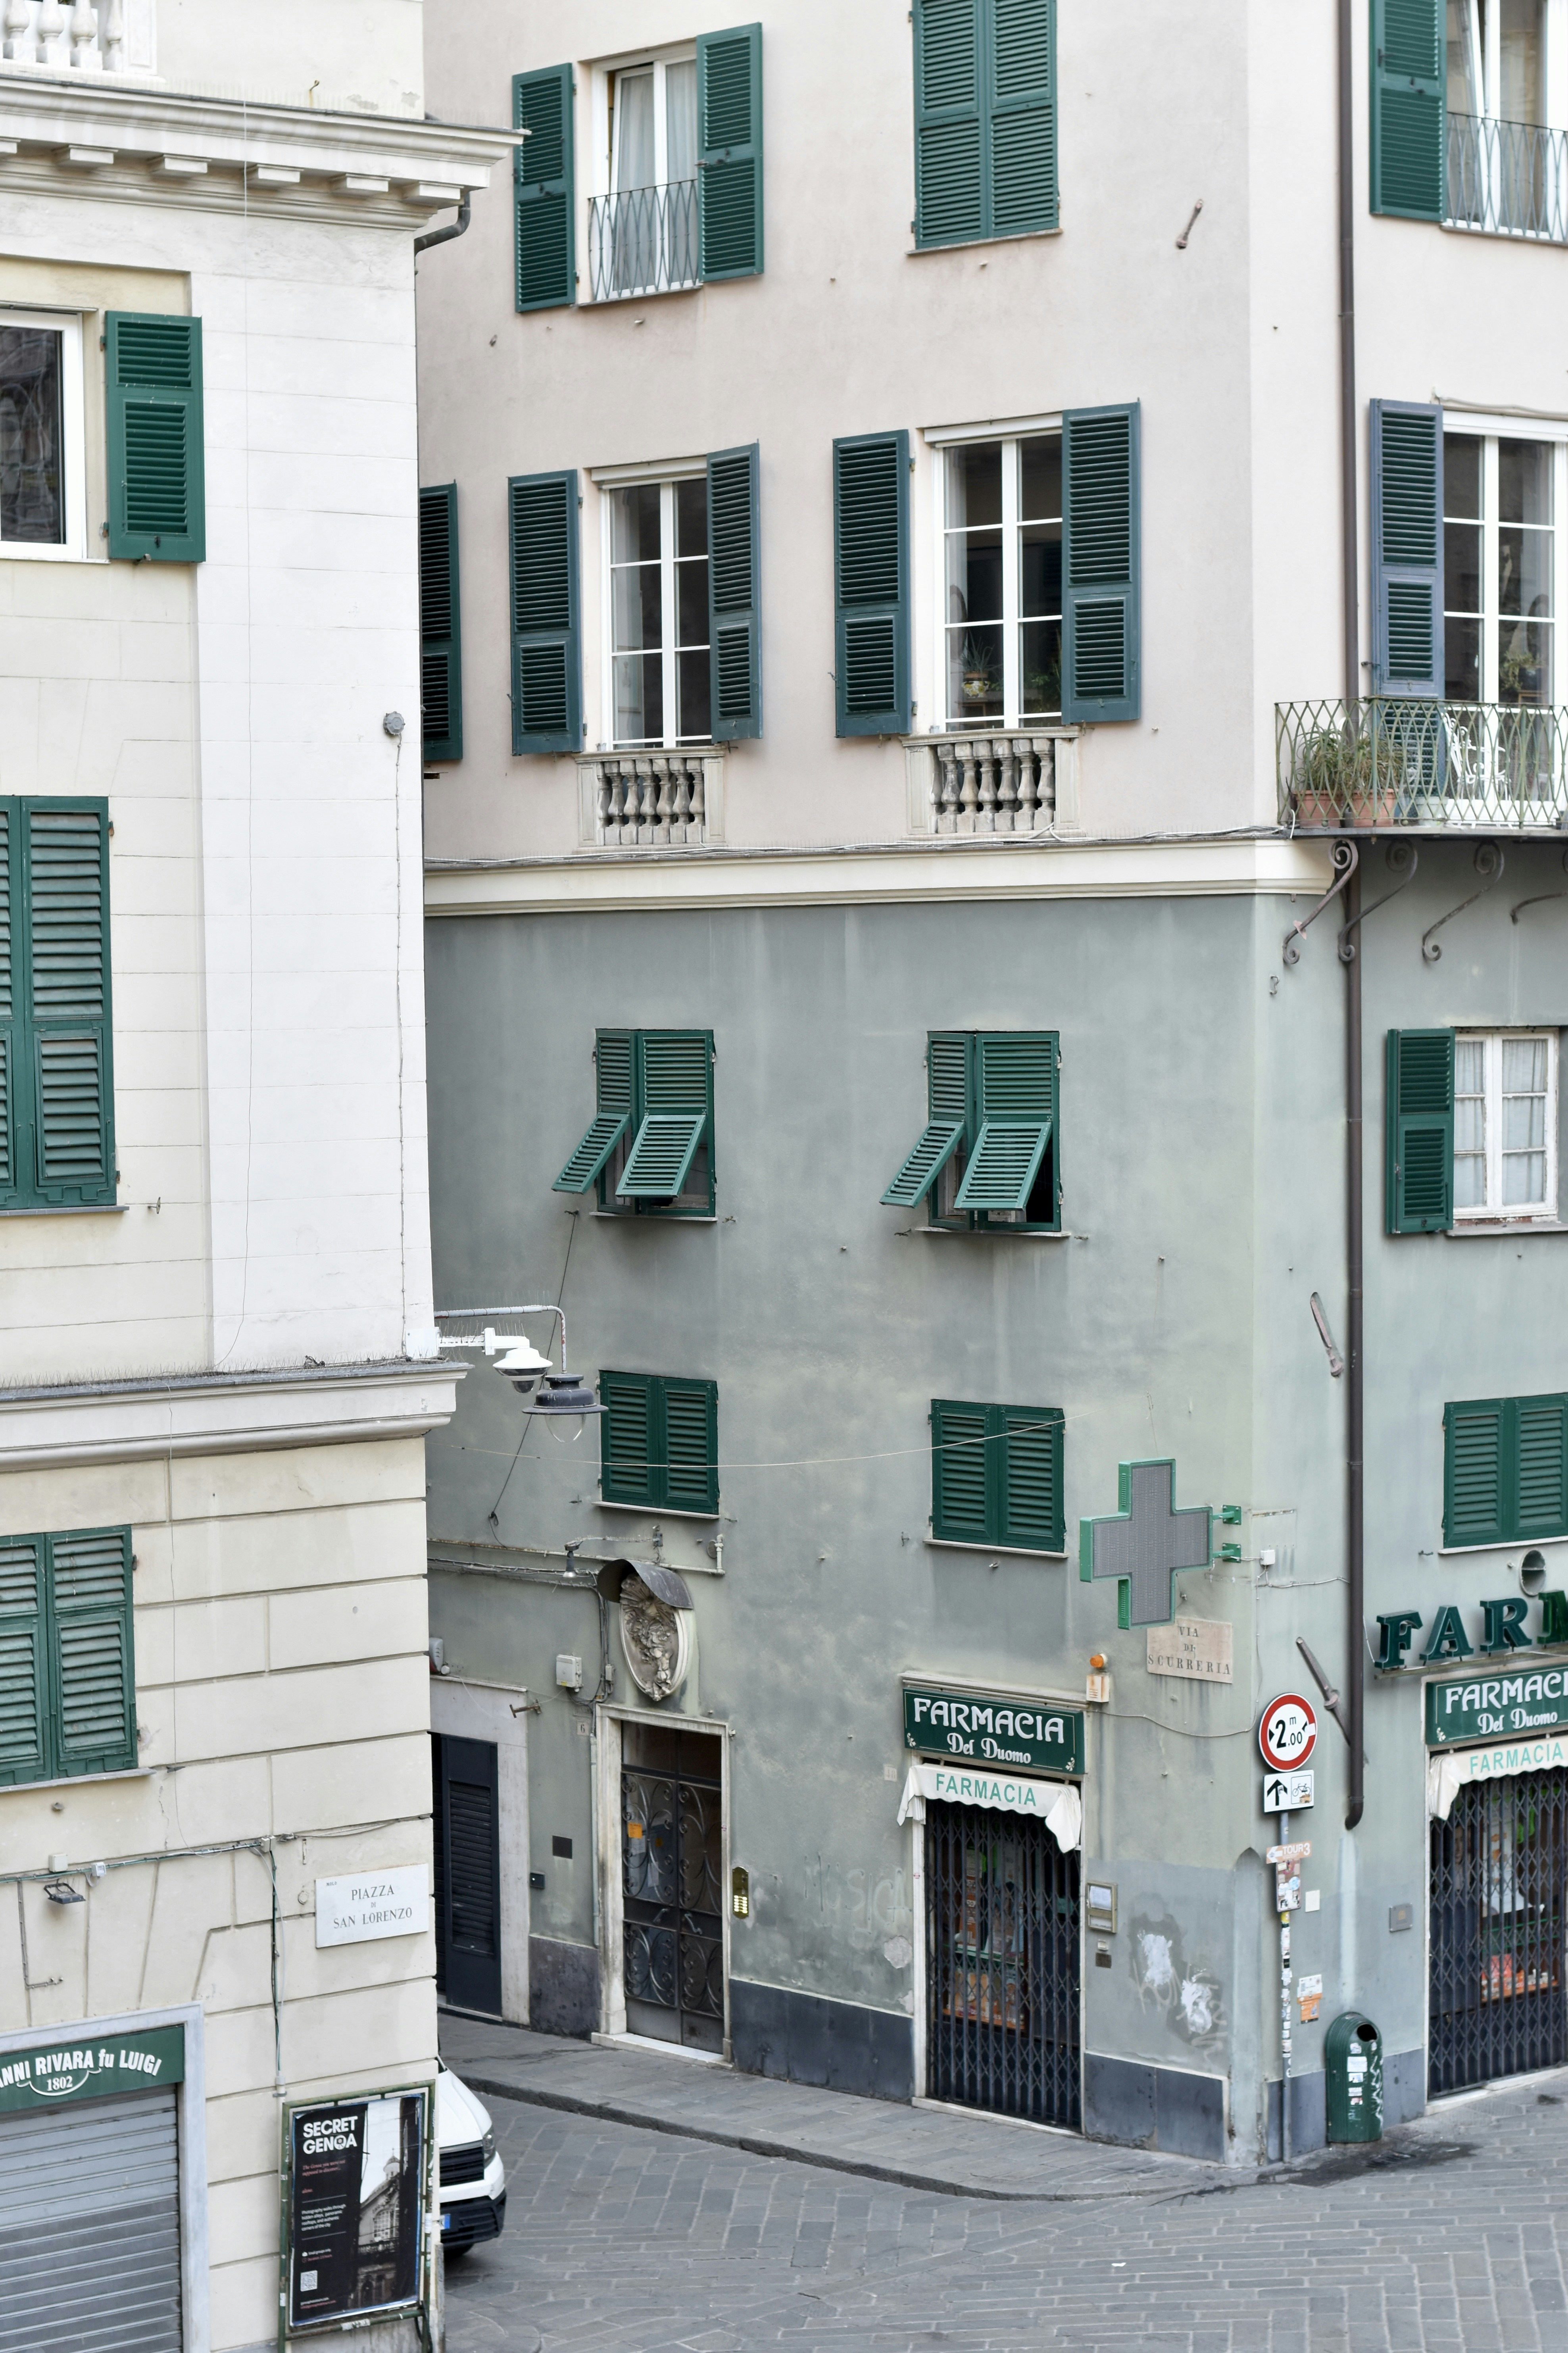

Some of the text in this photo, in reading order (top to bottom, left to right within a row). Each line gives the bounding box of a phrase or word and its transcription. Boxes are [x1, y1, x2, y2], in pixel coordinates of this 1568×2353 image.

[1178, 1626, 1198, 1637] VIA
[1184, 1644, 1193, 1652] DI
[1148, 1654, 1231, 1675] SCURRERIA
[580, 1723, 585, 1733] 6
[914, 1698, 1064, 1744] FARMACIA
[1478, 1708, 1558, 1734] Del Duomo
[947, 1733, 1031, 1764] Del Duomo
[1470, 1742, 1564, 1774] FARMACIA
[936, 1773, 1036, 1806] FARMACIA
[1282, 1842, 1311, 1856] TOUR 3
[352, 1885, 394, 1900] PIAZZA
[334, 1907, 412, 1929] SAN LORENZO
[35, 2050, 94, 2076] RIVARA
[98, 2049, 114, 2068] fu
[119, 2050, 162, 2076] LUIGI
[46, 2076, 73, 2091] 1802
[303, 2116, 358, 2138] SECRET
[303, 2133, 357, 2154] GENOA
